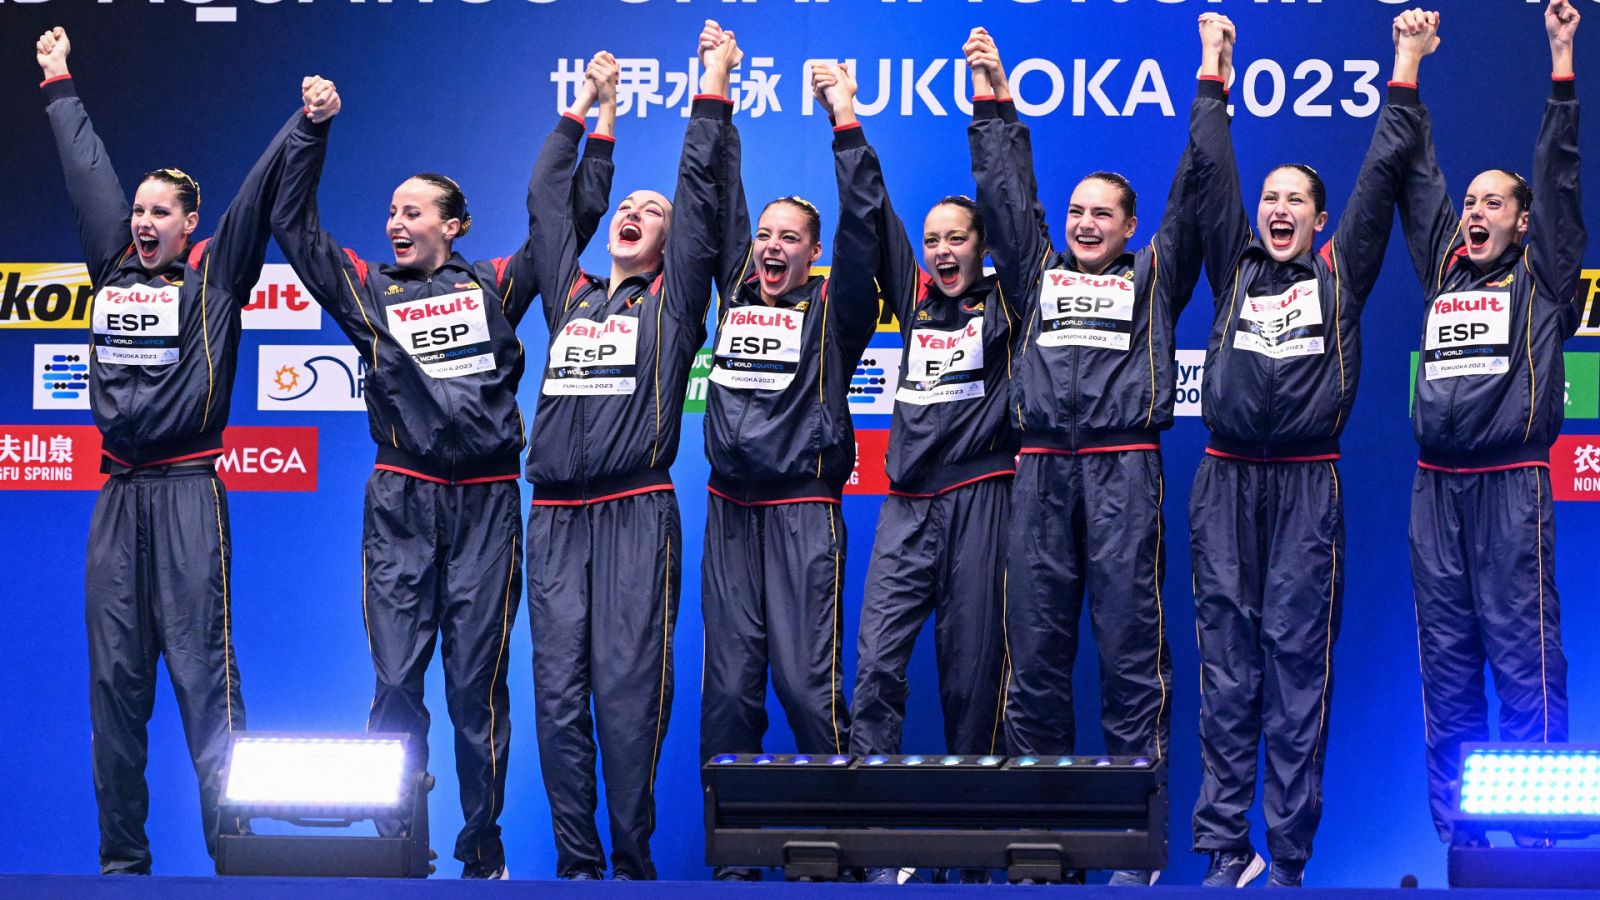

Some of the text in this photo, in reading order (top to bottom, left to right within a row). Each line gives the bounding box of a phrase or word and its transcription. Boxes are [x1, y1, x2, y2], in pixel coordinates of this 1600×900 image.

[551, 57, 782, 118] 世界水泳
[0, 272, 93, 321] ko
[1057, 296, 1115, 314] ESP
[1434, 297, 1504, 314] Yakult
[393, 296, 479, 322] Yakult
[106, 314, 159, 331] ESP
[730, 311, 797, 330] Yakult
[411, 323, 470, 349] ESP
[917, 324, 977, 349] Yakt
[1439, 323, 1489, 343] ESP
[565, 344, 617, 363] ESP
[729, 336, 782, 355] ESP
[420, 353, 445, 362] WORLD
[454, 363, 473, 371] 2023
[926, 350, 965, 377] EP
[0, 433, 73, 463] 夫山泉
[215, 447, 307, 474] MEGA
[0, 466, 73, 481] FU SPRING
